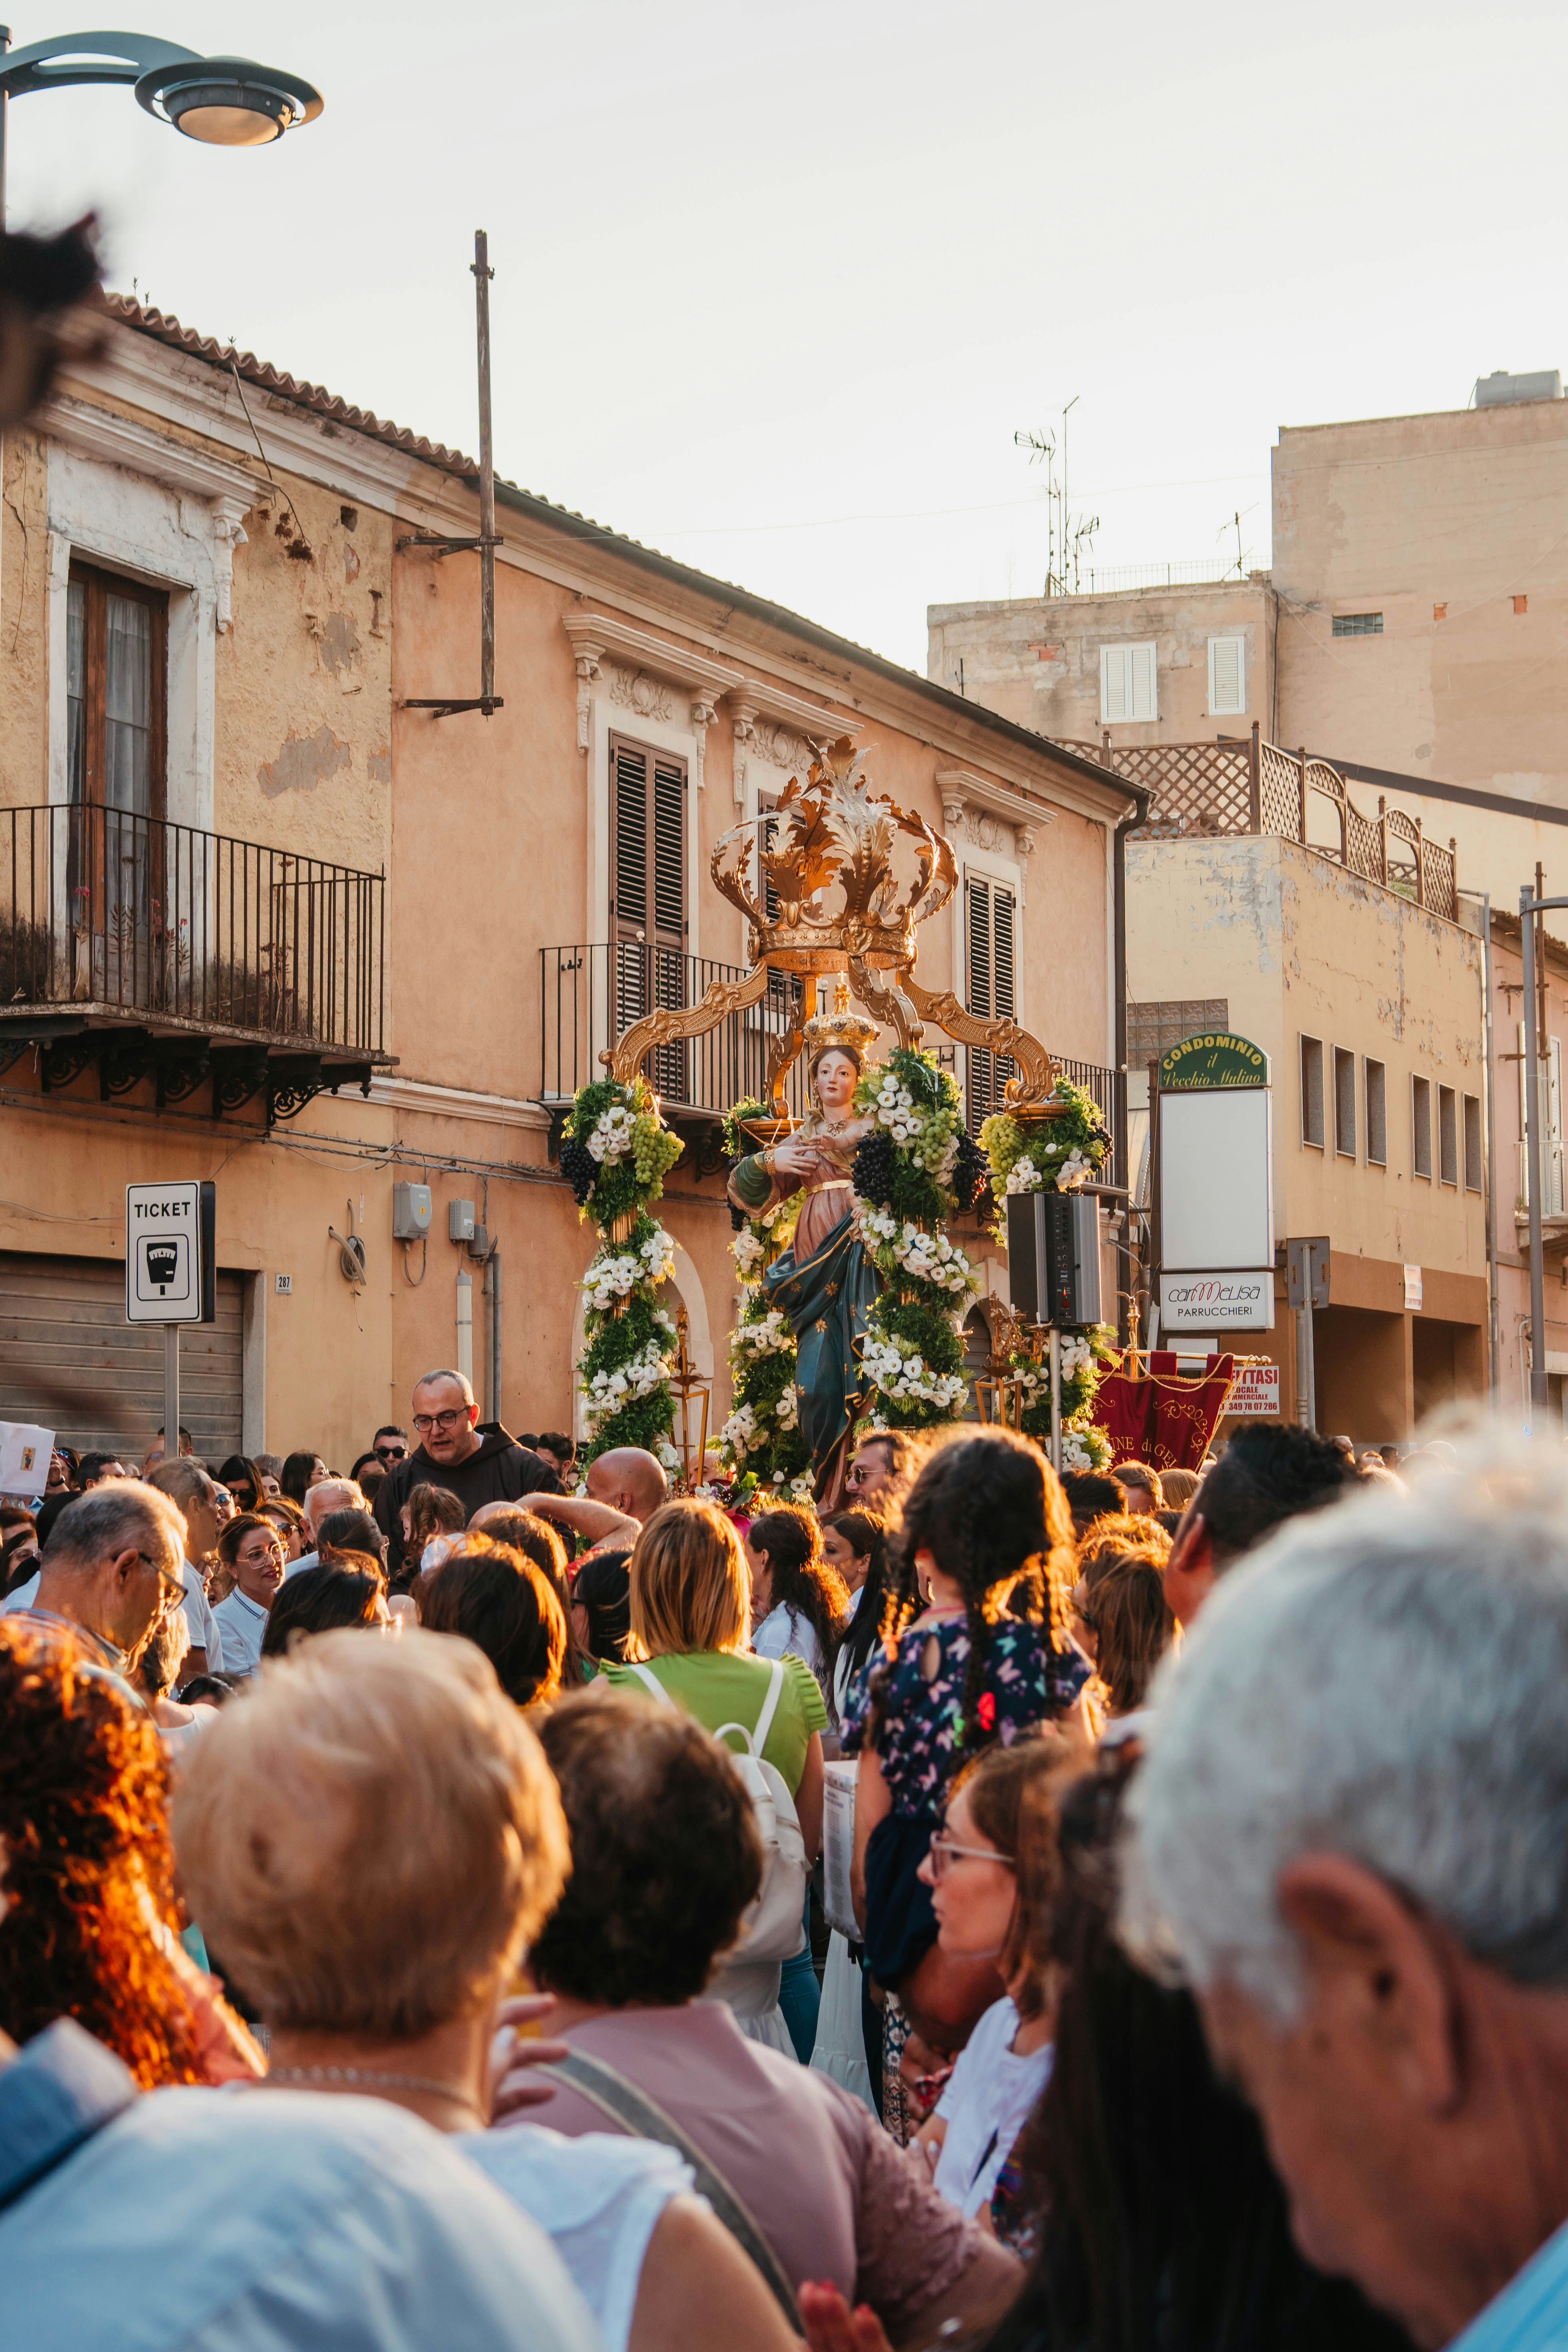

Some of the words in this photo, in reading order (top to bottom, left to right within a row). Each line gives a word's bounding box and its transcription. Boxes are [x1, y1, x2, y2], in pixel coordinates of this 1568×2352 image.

[1163, 1036, 1262, 1070] CONDOMINIO
[1207, 1052, 1218, 1068] il
[1164, 1071, 1210, 1087] Vecchio
[1213, 1068, 1261, 1085] Mulino
[134, 1202, 191, 1218] TICKET
[279, 1276, 290, 1288] 287
[1178, 1307, 1252, 1317] PARRUCCHIERI
[1142, 1438, 1152, 1452] di
